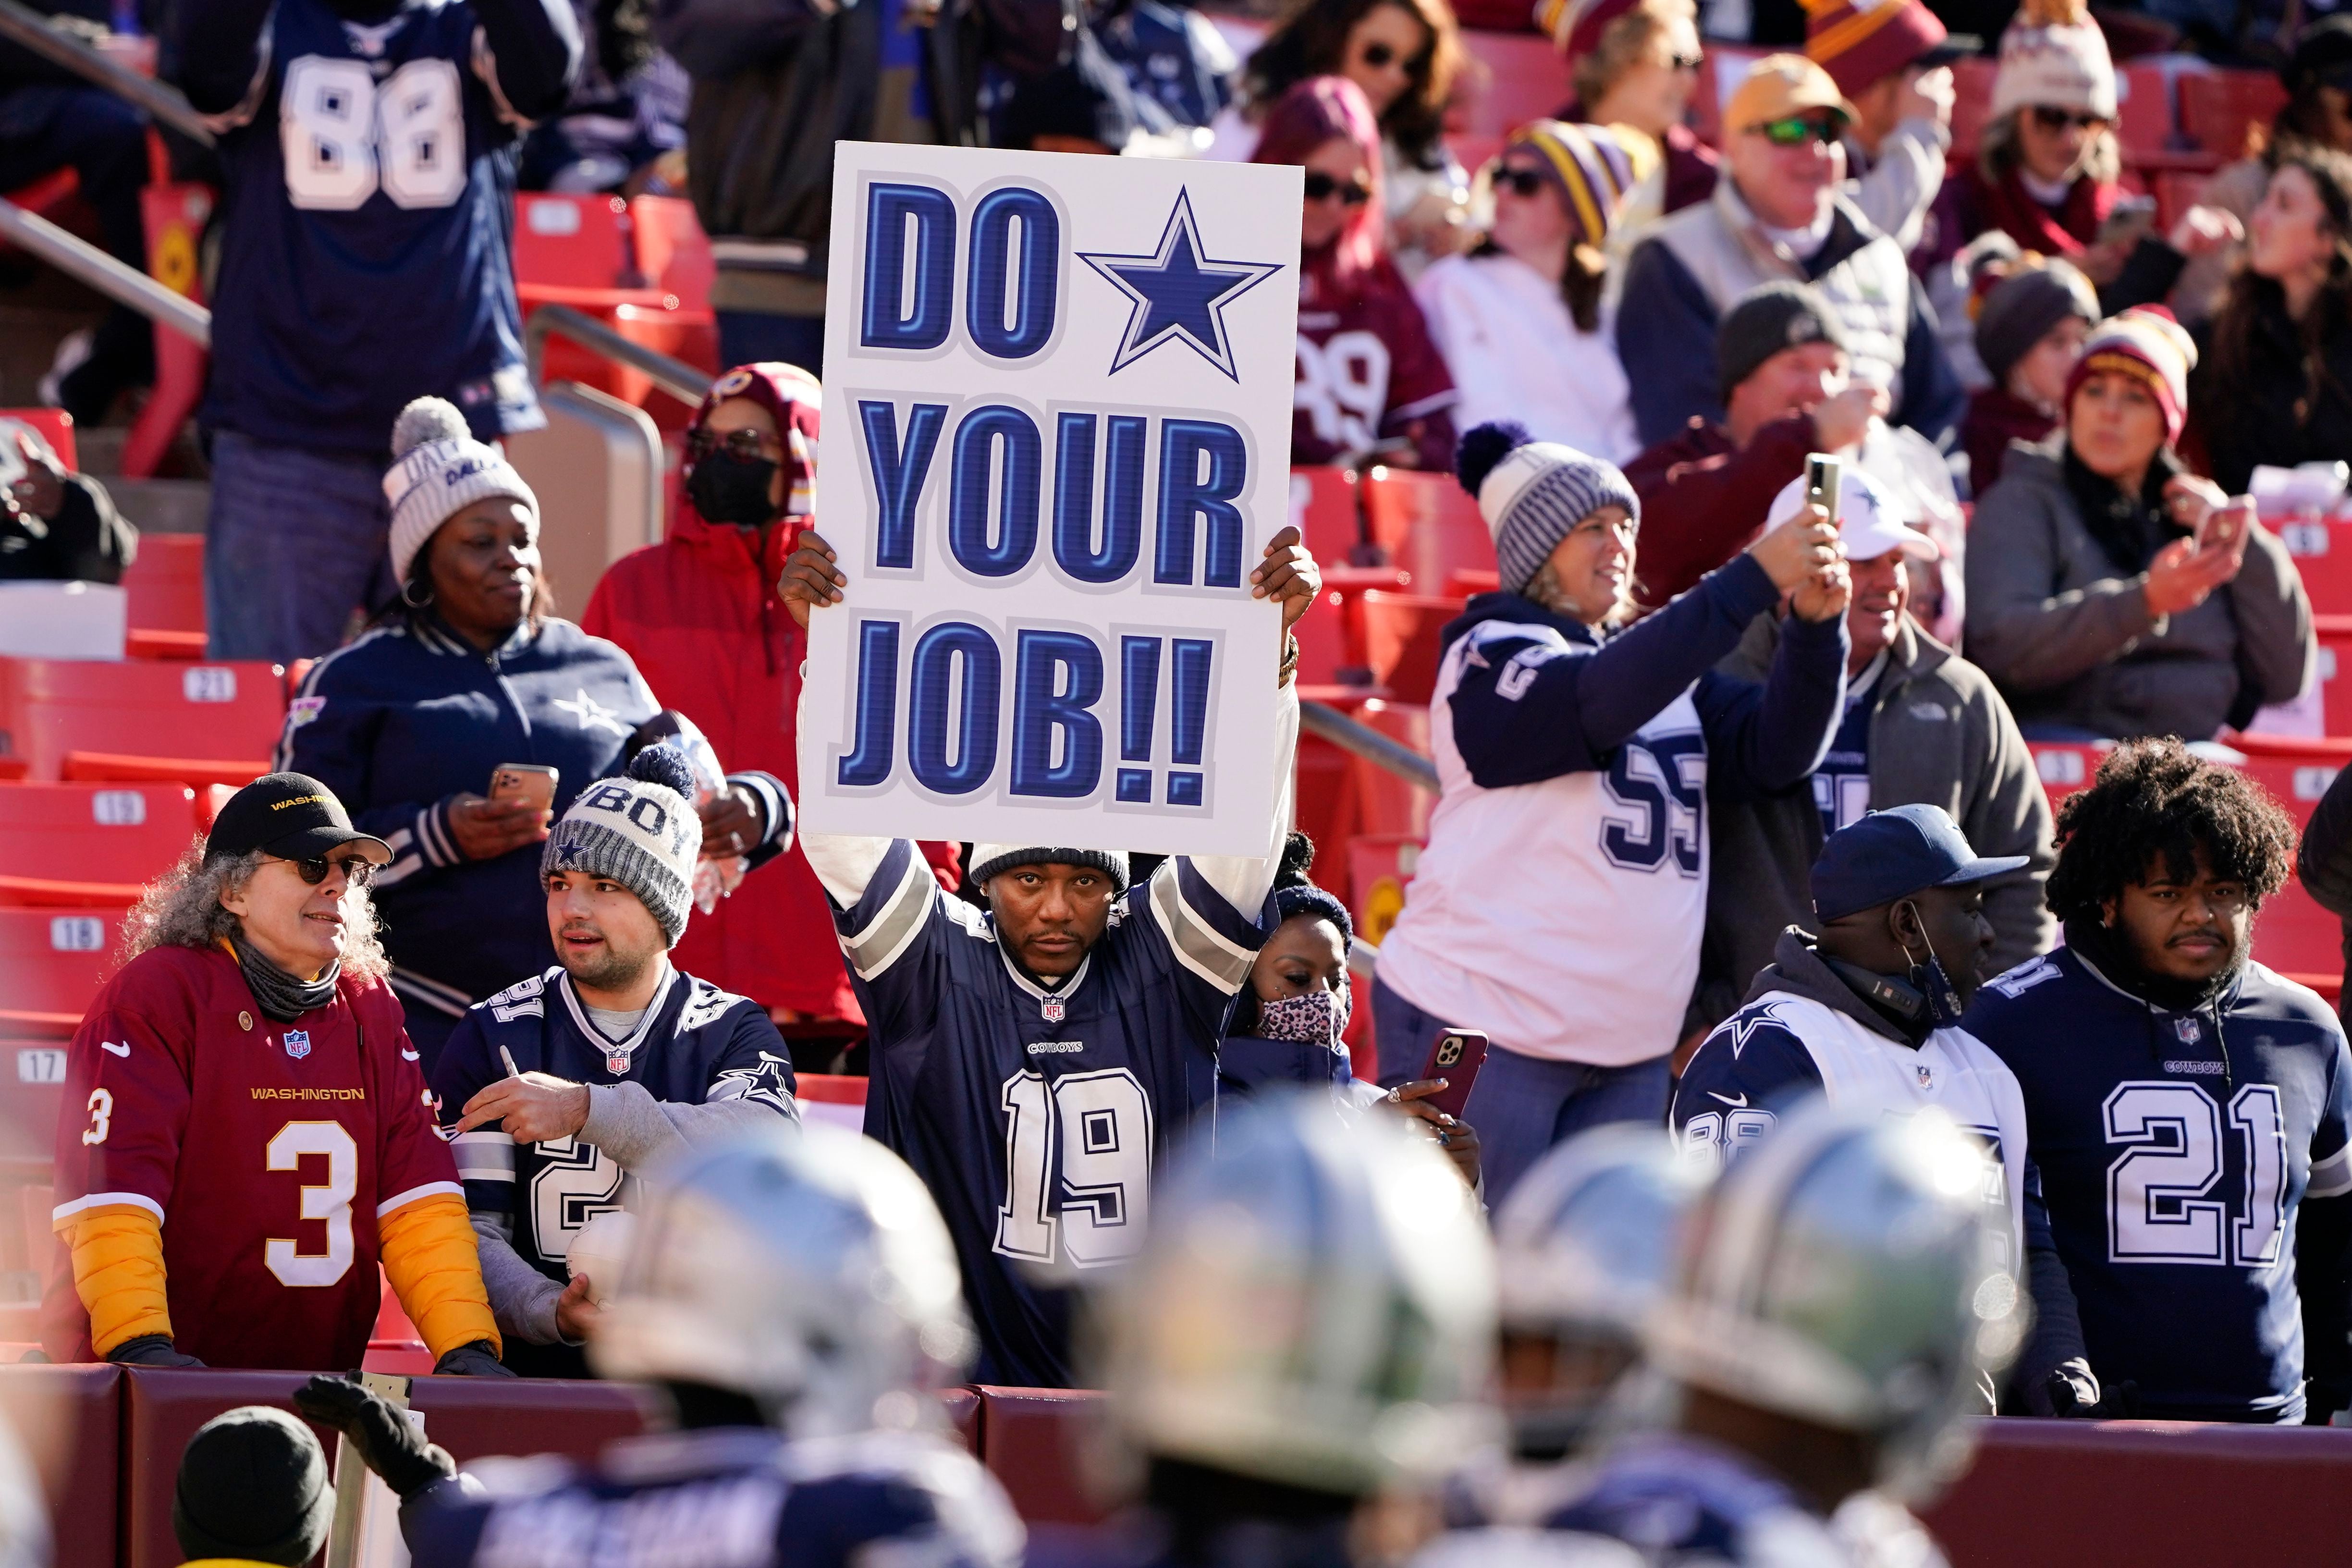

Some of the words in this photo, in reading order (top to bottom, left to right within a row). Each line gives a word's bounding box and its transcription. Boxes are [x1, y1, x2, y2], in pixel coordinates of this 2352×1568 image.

[279, 52, 468, 211] 88
[860, 181, 1060, 361] DO
[856, 399, 1251, 590] YOUR
[836, 617, 1214, 808] JOB!!
[1598, 726, 1708, 880] 55
[64, 919, 93, 948] 18
[30, 1053, 55, 1080] 17
[289, 1041, 307, 1054] NFL
[610, 1059, 627, 1071] NFL
[1046, 1005, 1062, 1017] NFL
[81, 1088, 113, 1146] 3
[250, 1087, 366, 1101] WASHINGTON
[992, 1067, 1154, 1270] 19
[264, 1120, 358, 1287] 3
[2102, 1080, 2288, 1269] 21
